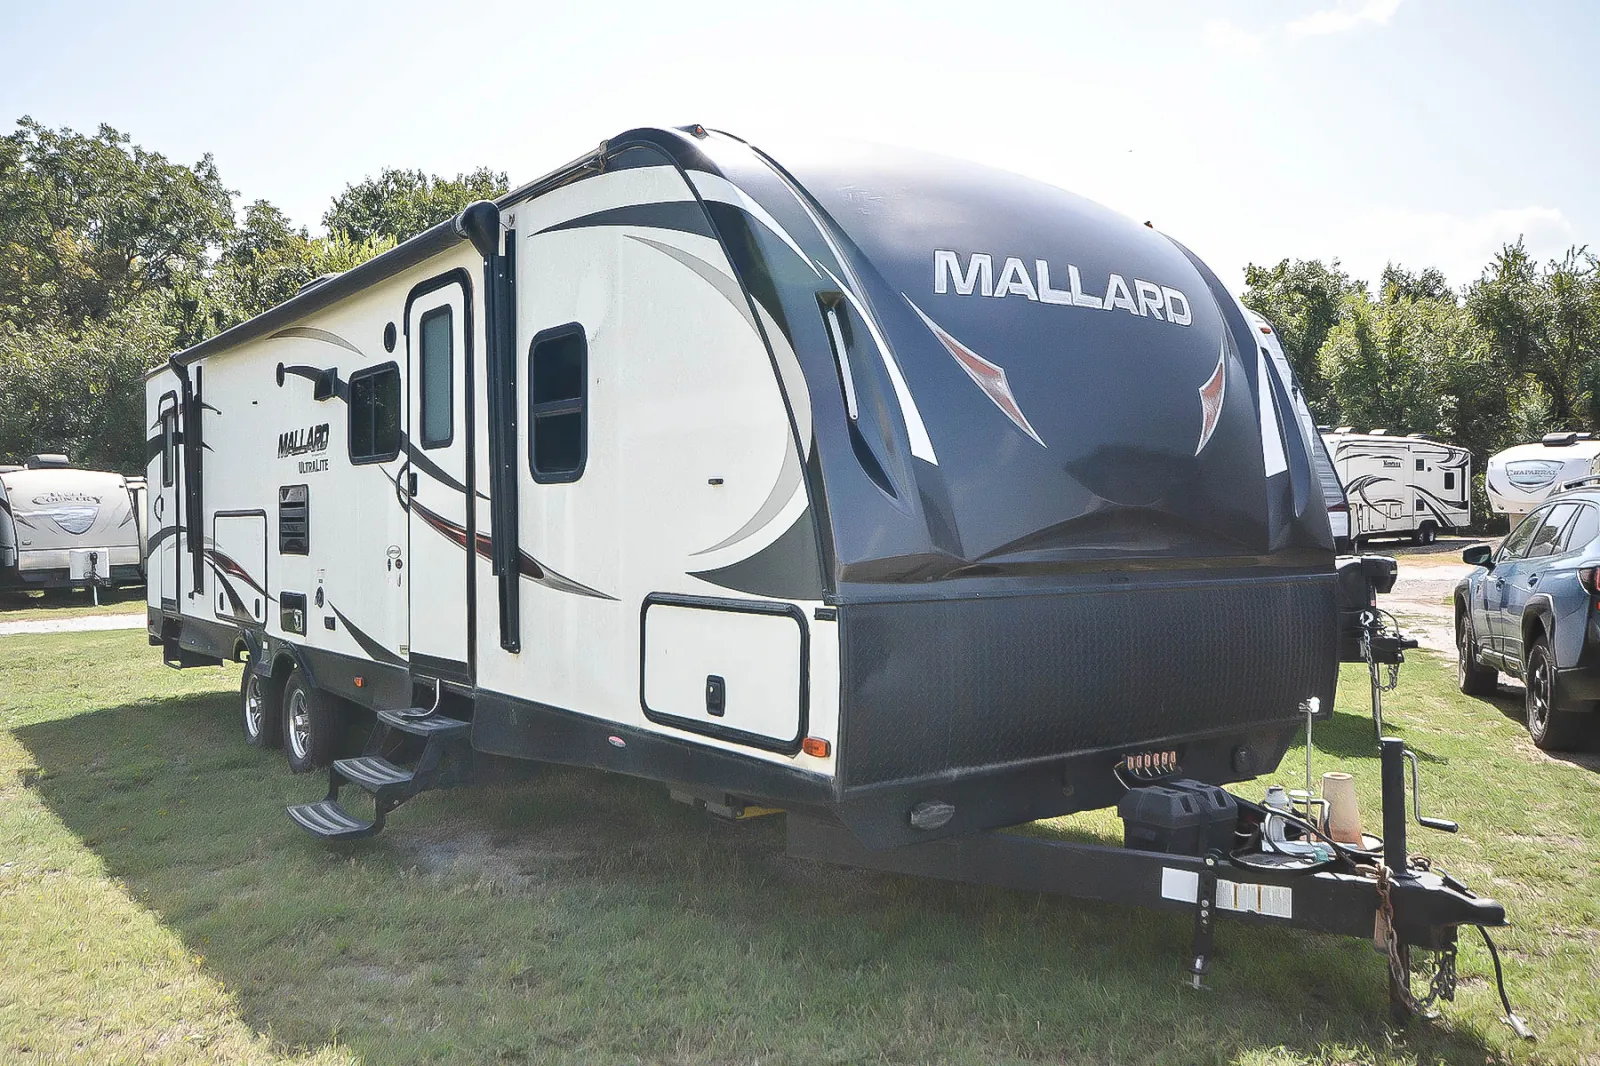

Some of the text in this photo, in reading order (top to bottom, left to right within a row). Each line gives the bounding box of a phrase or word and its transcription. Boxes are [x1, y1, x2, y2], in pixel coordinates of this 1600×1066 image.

[933, 249, 1193, 327] MALLARD
[277, 422, 330, 459] MALLARD
[298, 458, 329, 474] ULTRALITE
